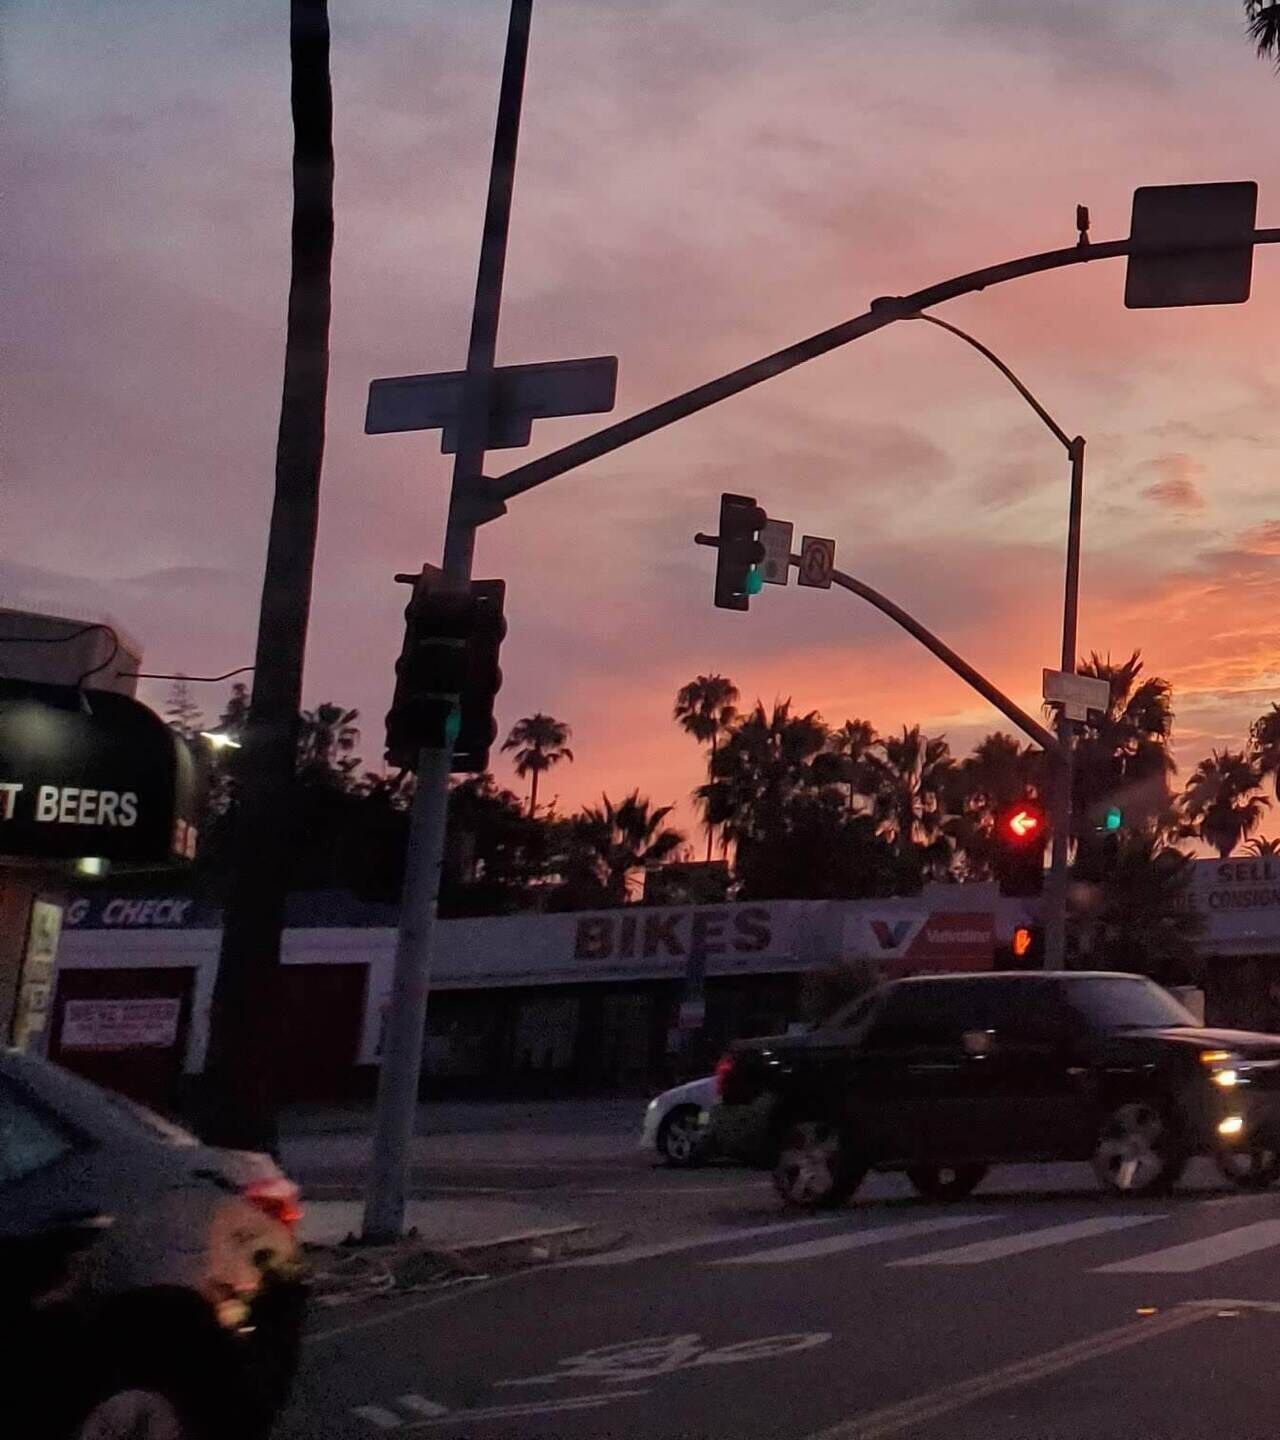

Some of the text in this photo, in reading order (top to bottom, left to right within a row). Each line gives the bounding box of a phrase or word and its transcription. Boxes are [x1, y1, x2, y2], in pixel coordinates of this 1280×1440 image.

[35, 785, 139, 827] BEERS
[1216, 863, 1277, 882] SELL
[101, 898, 195, 925] CHECK
[575, 910, 772, 959] BIKES
